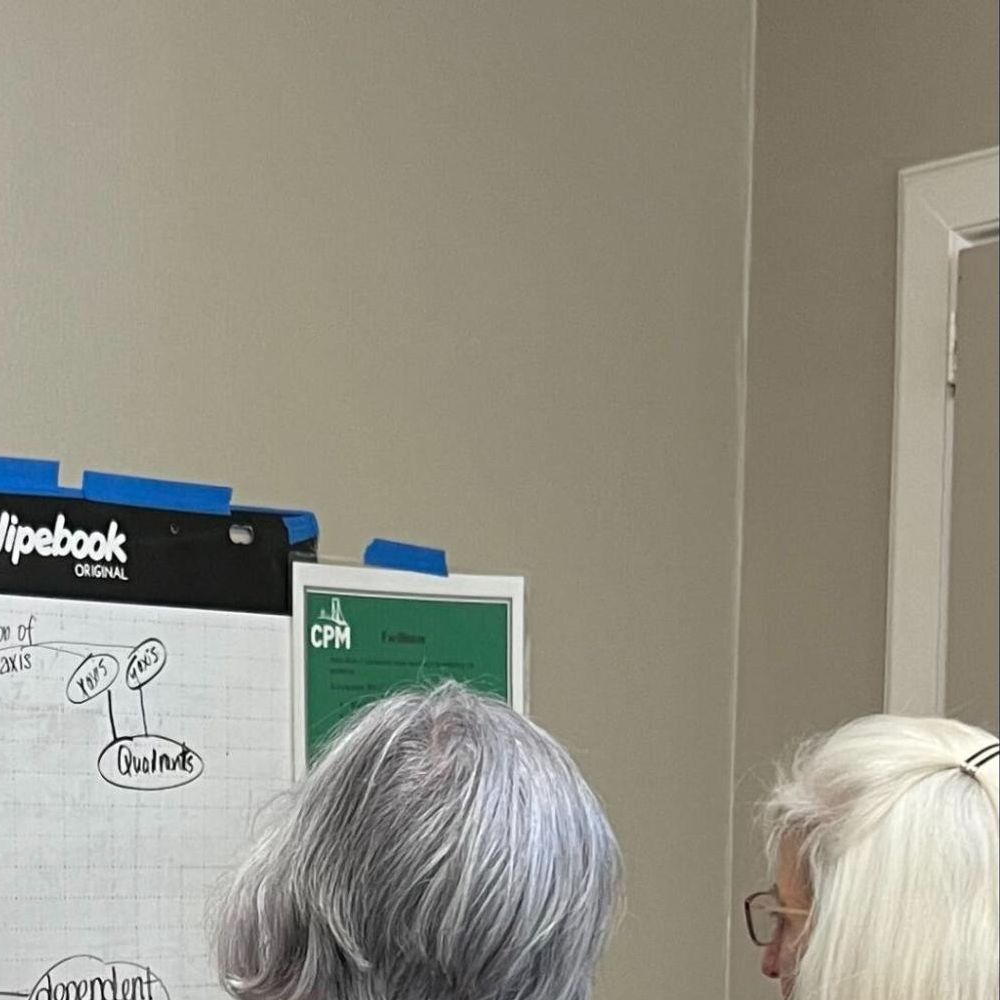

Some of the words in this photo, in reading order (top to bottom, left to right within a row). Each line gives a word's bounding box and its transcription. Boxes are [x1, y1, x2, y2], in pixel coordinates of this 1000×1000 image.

[74, 564, 128, 580] ORIGINAL
[18, 613, 36, 646] of
[310, 624, 351, 650] CPM
